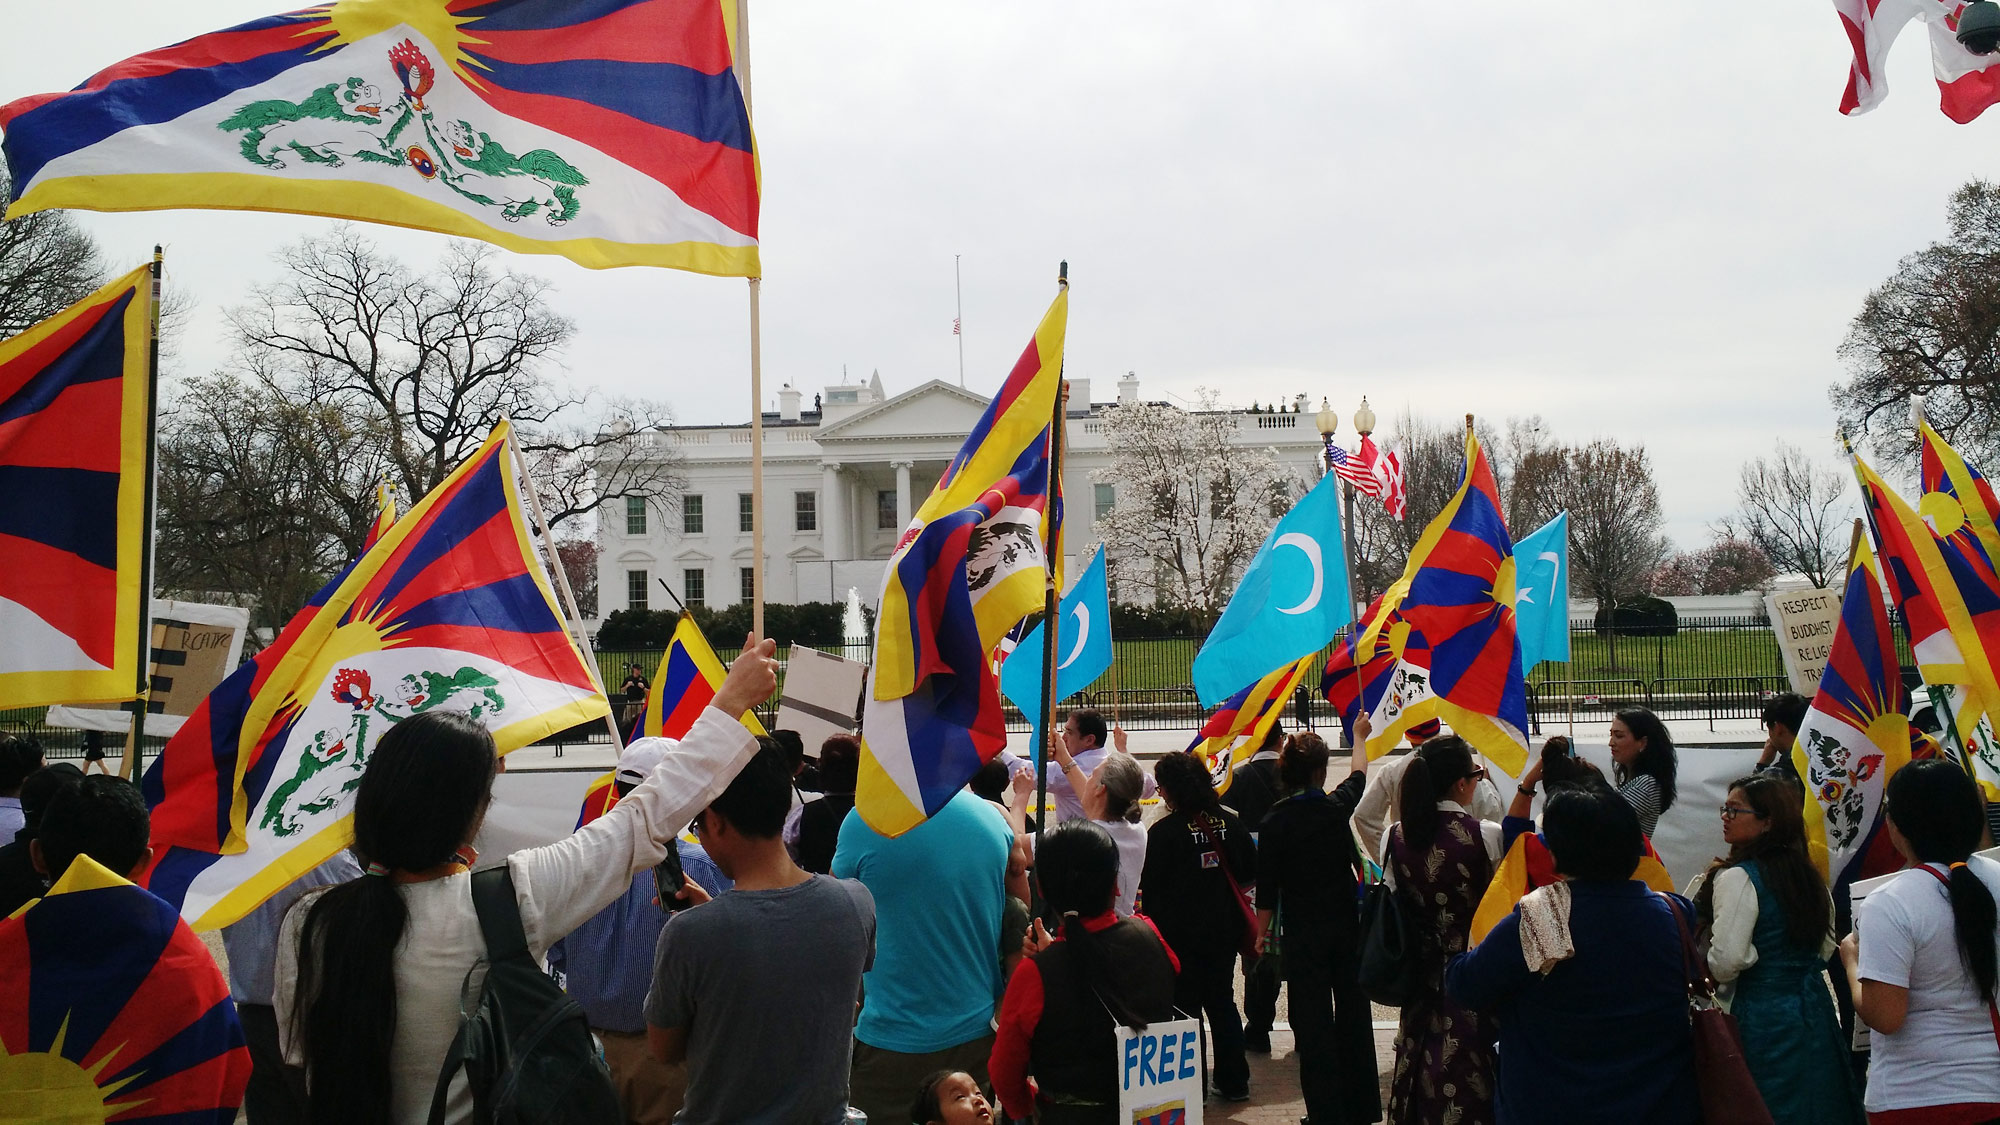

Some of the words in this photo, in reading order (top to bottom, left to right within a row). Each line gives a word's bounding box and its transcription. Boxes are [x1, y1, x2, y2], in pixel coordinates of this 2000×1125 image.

[1782, 596, 1828, 615] RESPECT
[1790, 620, 1833, 640] BUDDHIST
[1123, 1031, 1197, 1091] FREE
